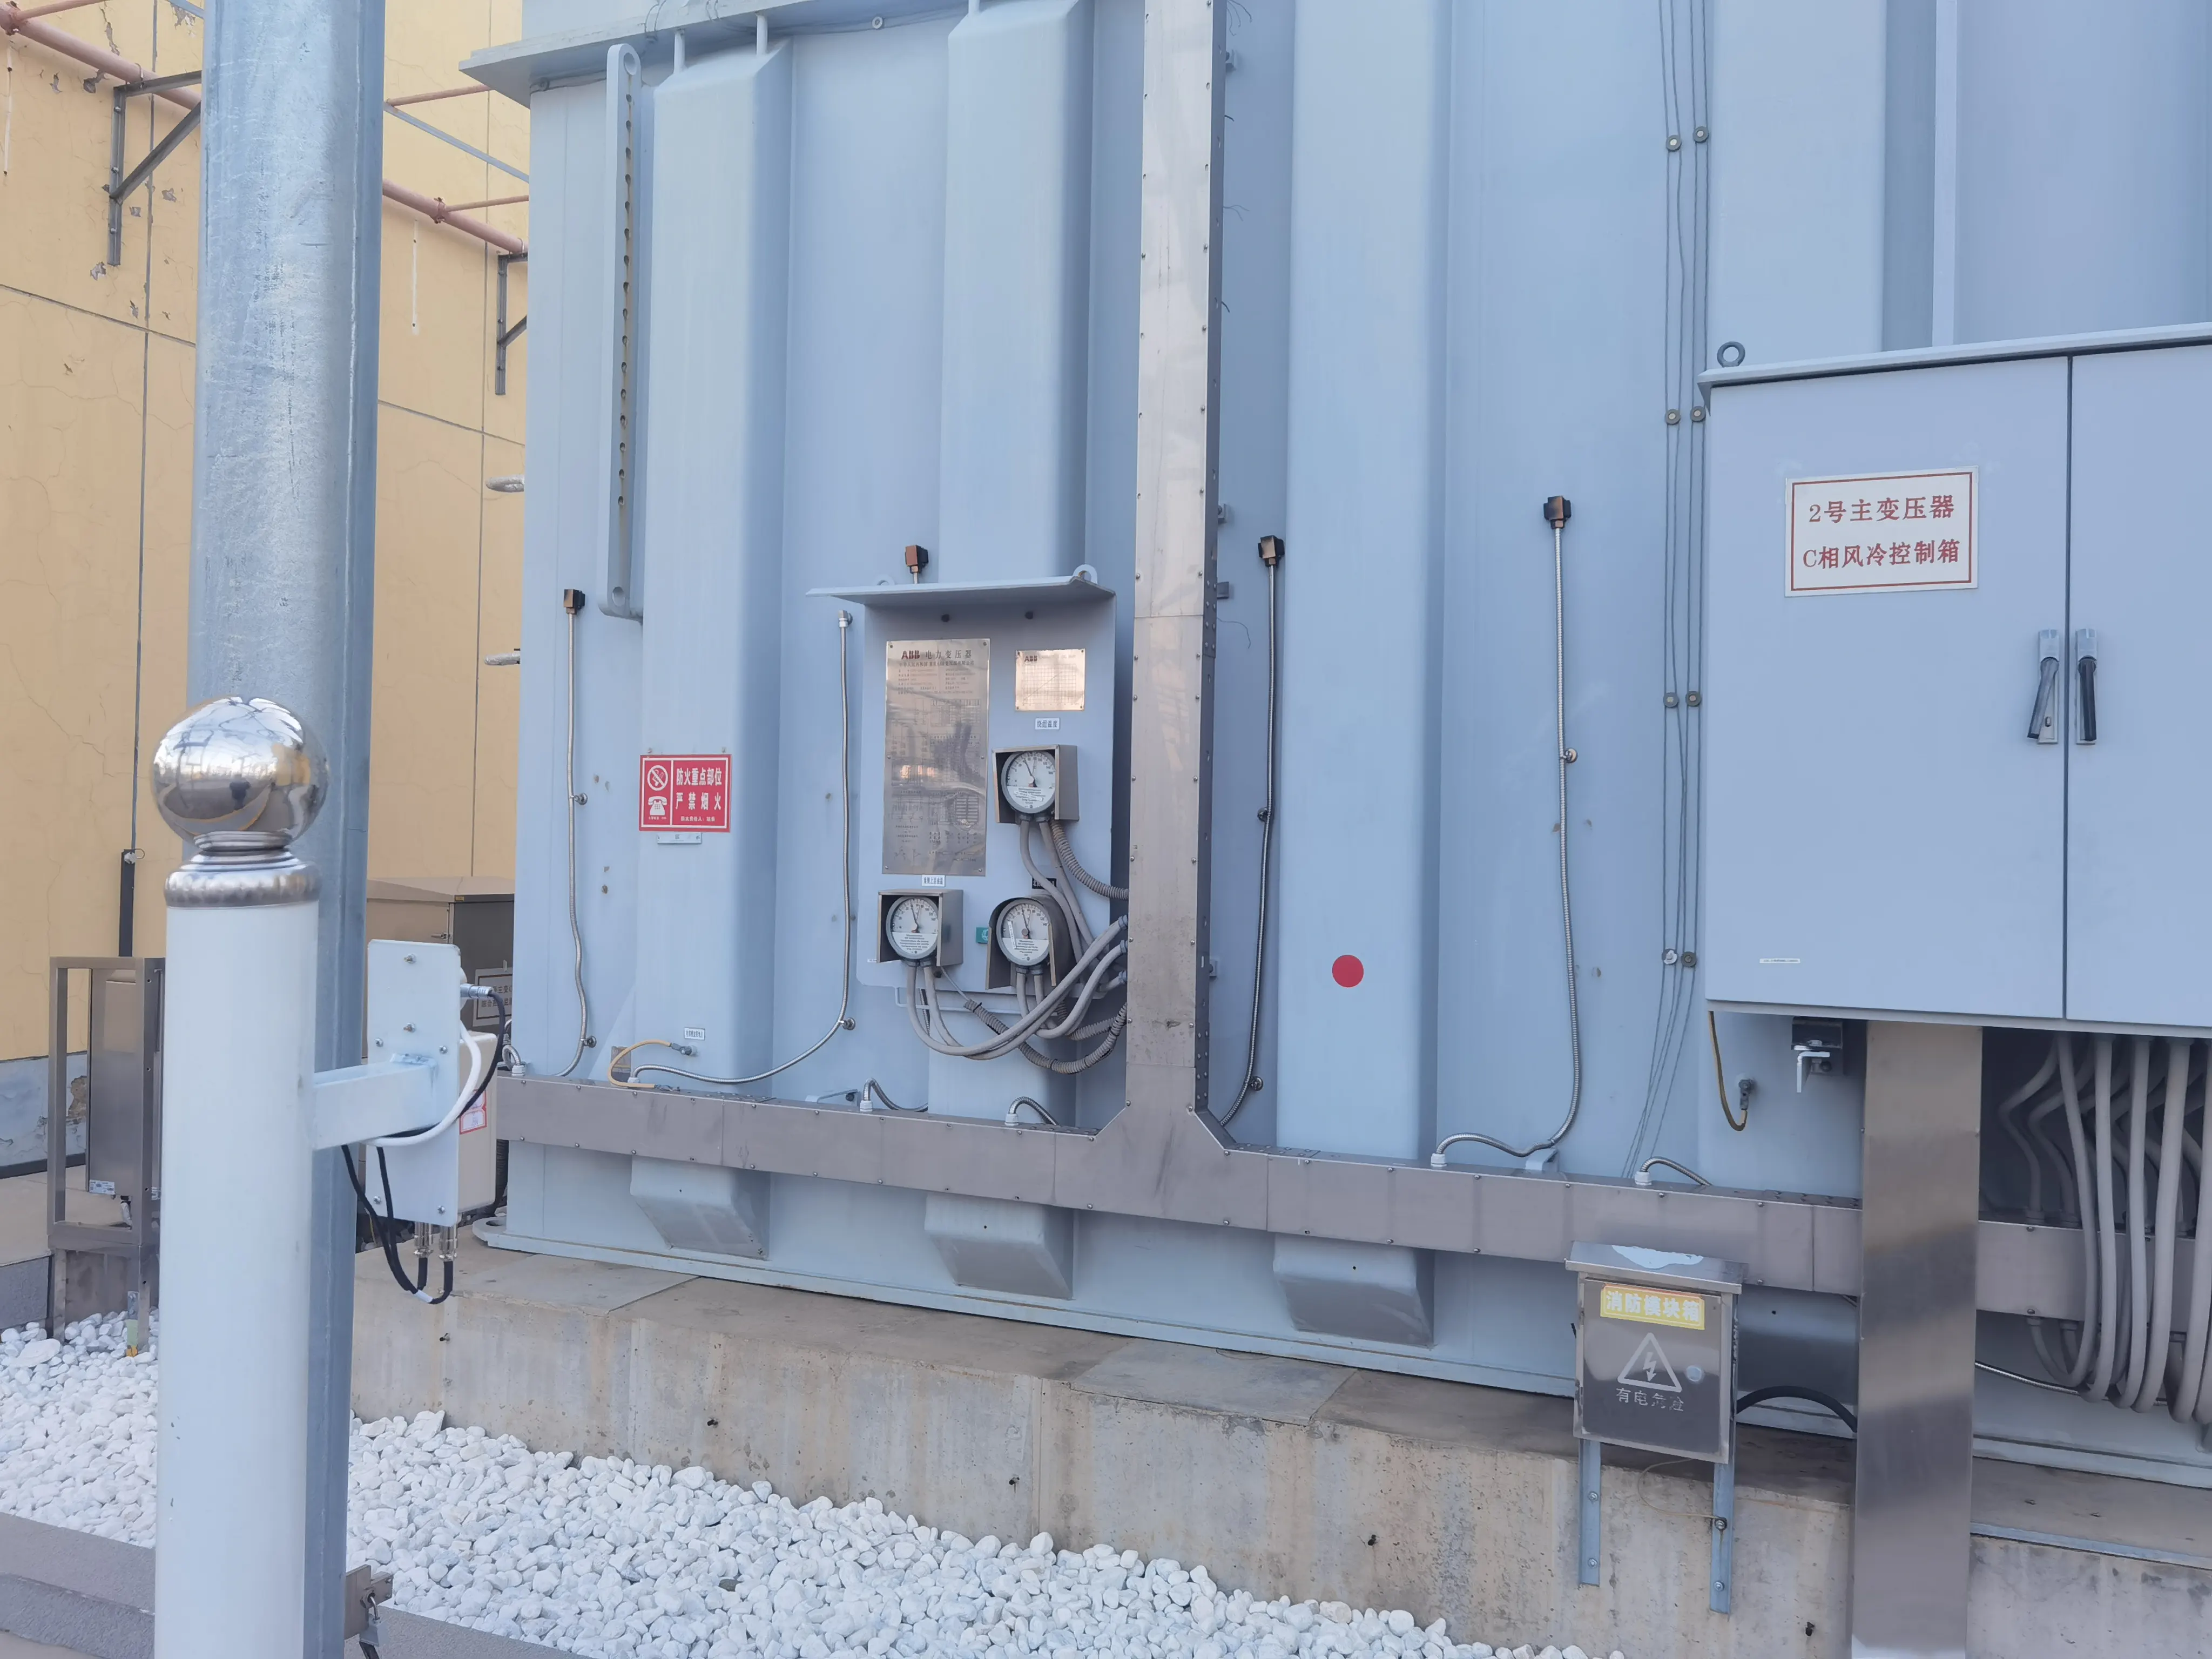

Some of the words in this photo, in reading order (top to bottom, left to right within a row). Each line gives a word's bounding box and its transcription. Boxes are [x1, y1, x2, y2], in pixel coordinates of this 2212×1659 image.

[1808, 494, 1955, 524] 2号主变压器
[1802, 538, 1961, 570] C相风冷控制箱
[901, 650, 920, 659] ABB
[925, 650, 972, 659] 电力变压器
[676, 767, 722, 786] 防火重点部位
[675, 792, 721, 810] 严禁烟火
[1606, 1290, 1701, 1322] 消防模块箱
